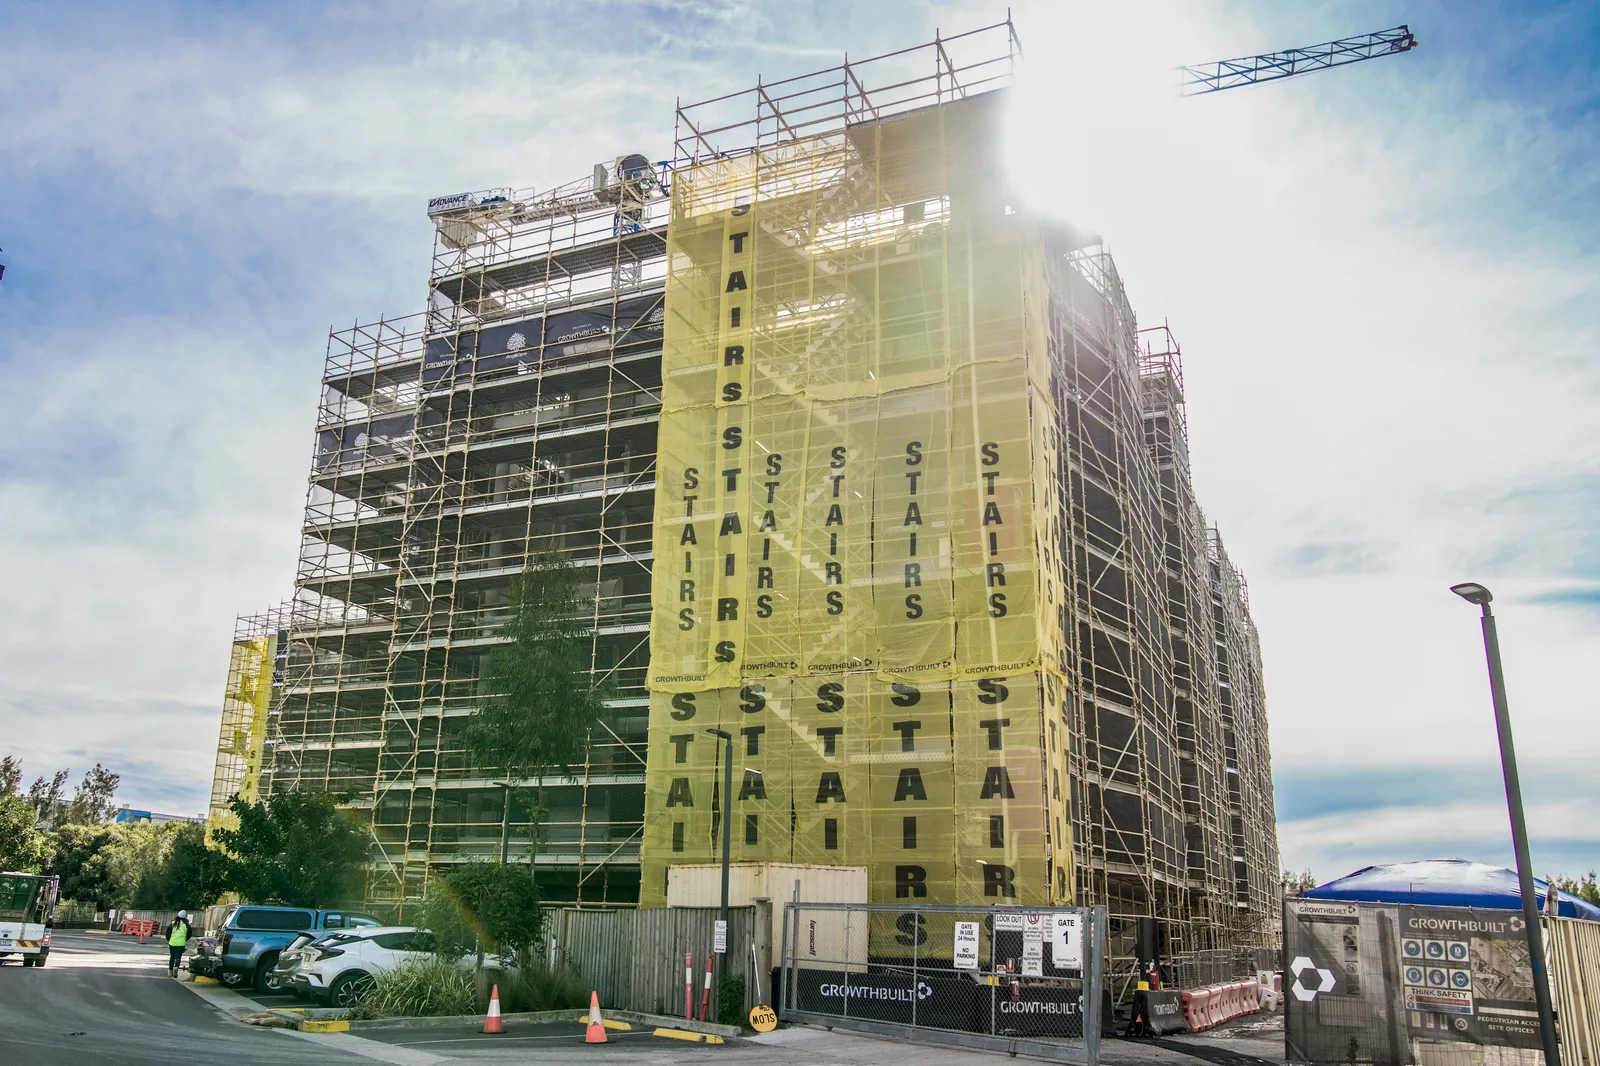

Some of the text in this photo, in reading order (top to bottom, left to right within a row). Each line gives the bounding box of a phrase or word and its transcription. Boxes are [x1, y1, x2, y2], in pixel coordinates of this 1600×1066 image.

[1042, 426, 1053, 604] STAIRS
[757, 453, 782, 618] STAIRS
[825, 446, 847, 615] STAIRS
[904, 441, 923, 619] STAIRS
[981, 441, 1007, 618] STAIRS
[678, 467, 699, 631] STAIRS
[715, 427, 743, 662] STAIRS
[740, 661, 788, 671] ROWTHBUILT
[807, 661, 862, 671] GROWTHBUILT
[883, 662, 941, 674] GROWTHBUILT
[965, 663, 1026, 675] GROWTHBUILT
[890, 682, 928, 946] STAIRS
[1299, 906, 1347, 914] GROWTHBUILT
[1408, 917, 1507, 933] GROWTHBUILT
[1063, 931, 1068, 945] 1
[820, 983, 914, 1001] GROWTHBUILT
[1411, 988, 1467, 999] THINK SAFETY
[1000, 1001, 1077, 1014] GROWTHBUILT
[752, 1013, 775, 1025] SLOW
[1477, 1016, 1519, 1025] PEDESTRIAN
[1505, 1026, 1535, 1034] OFFICES
